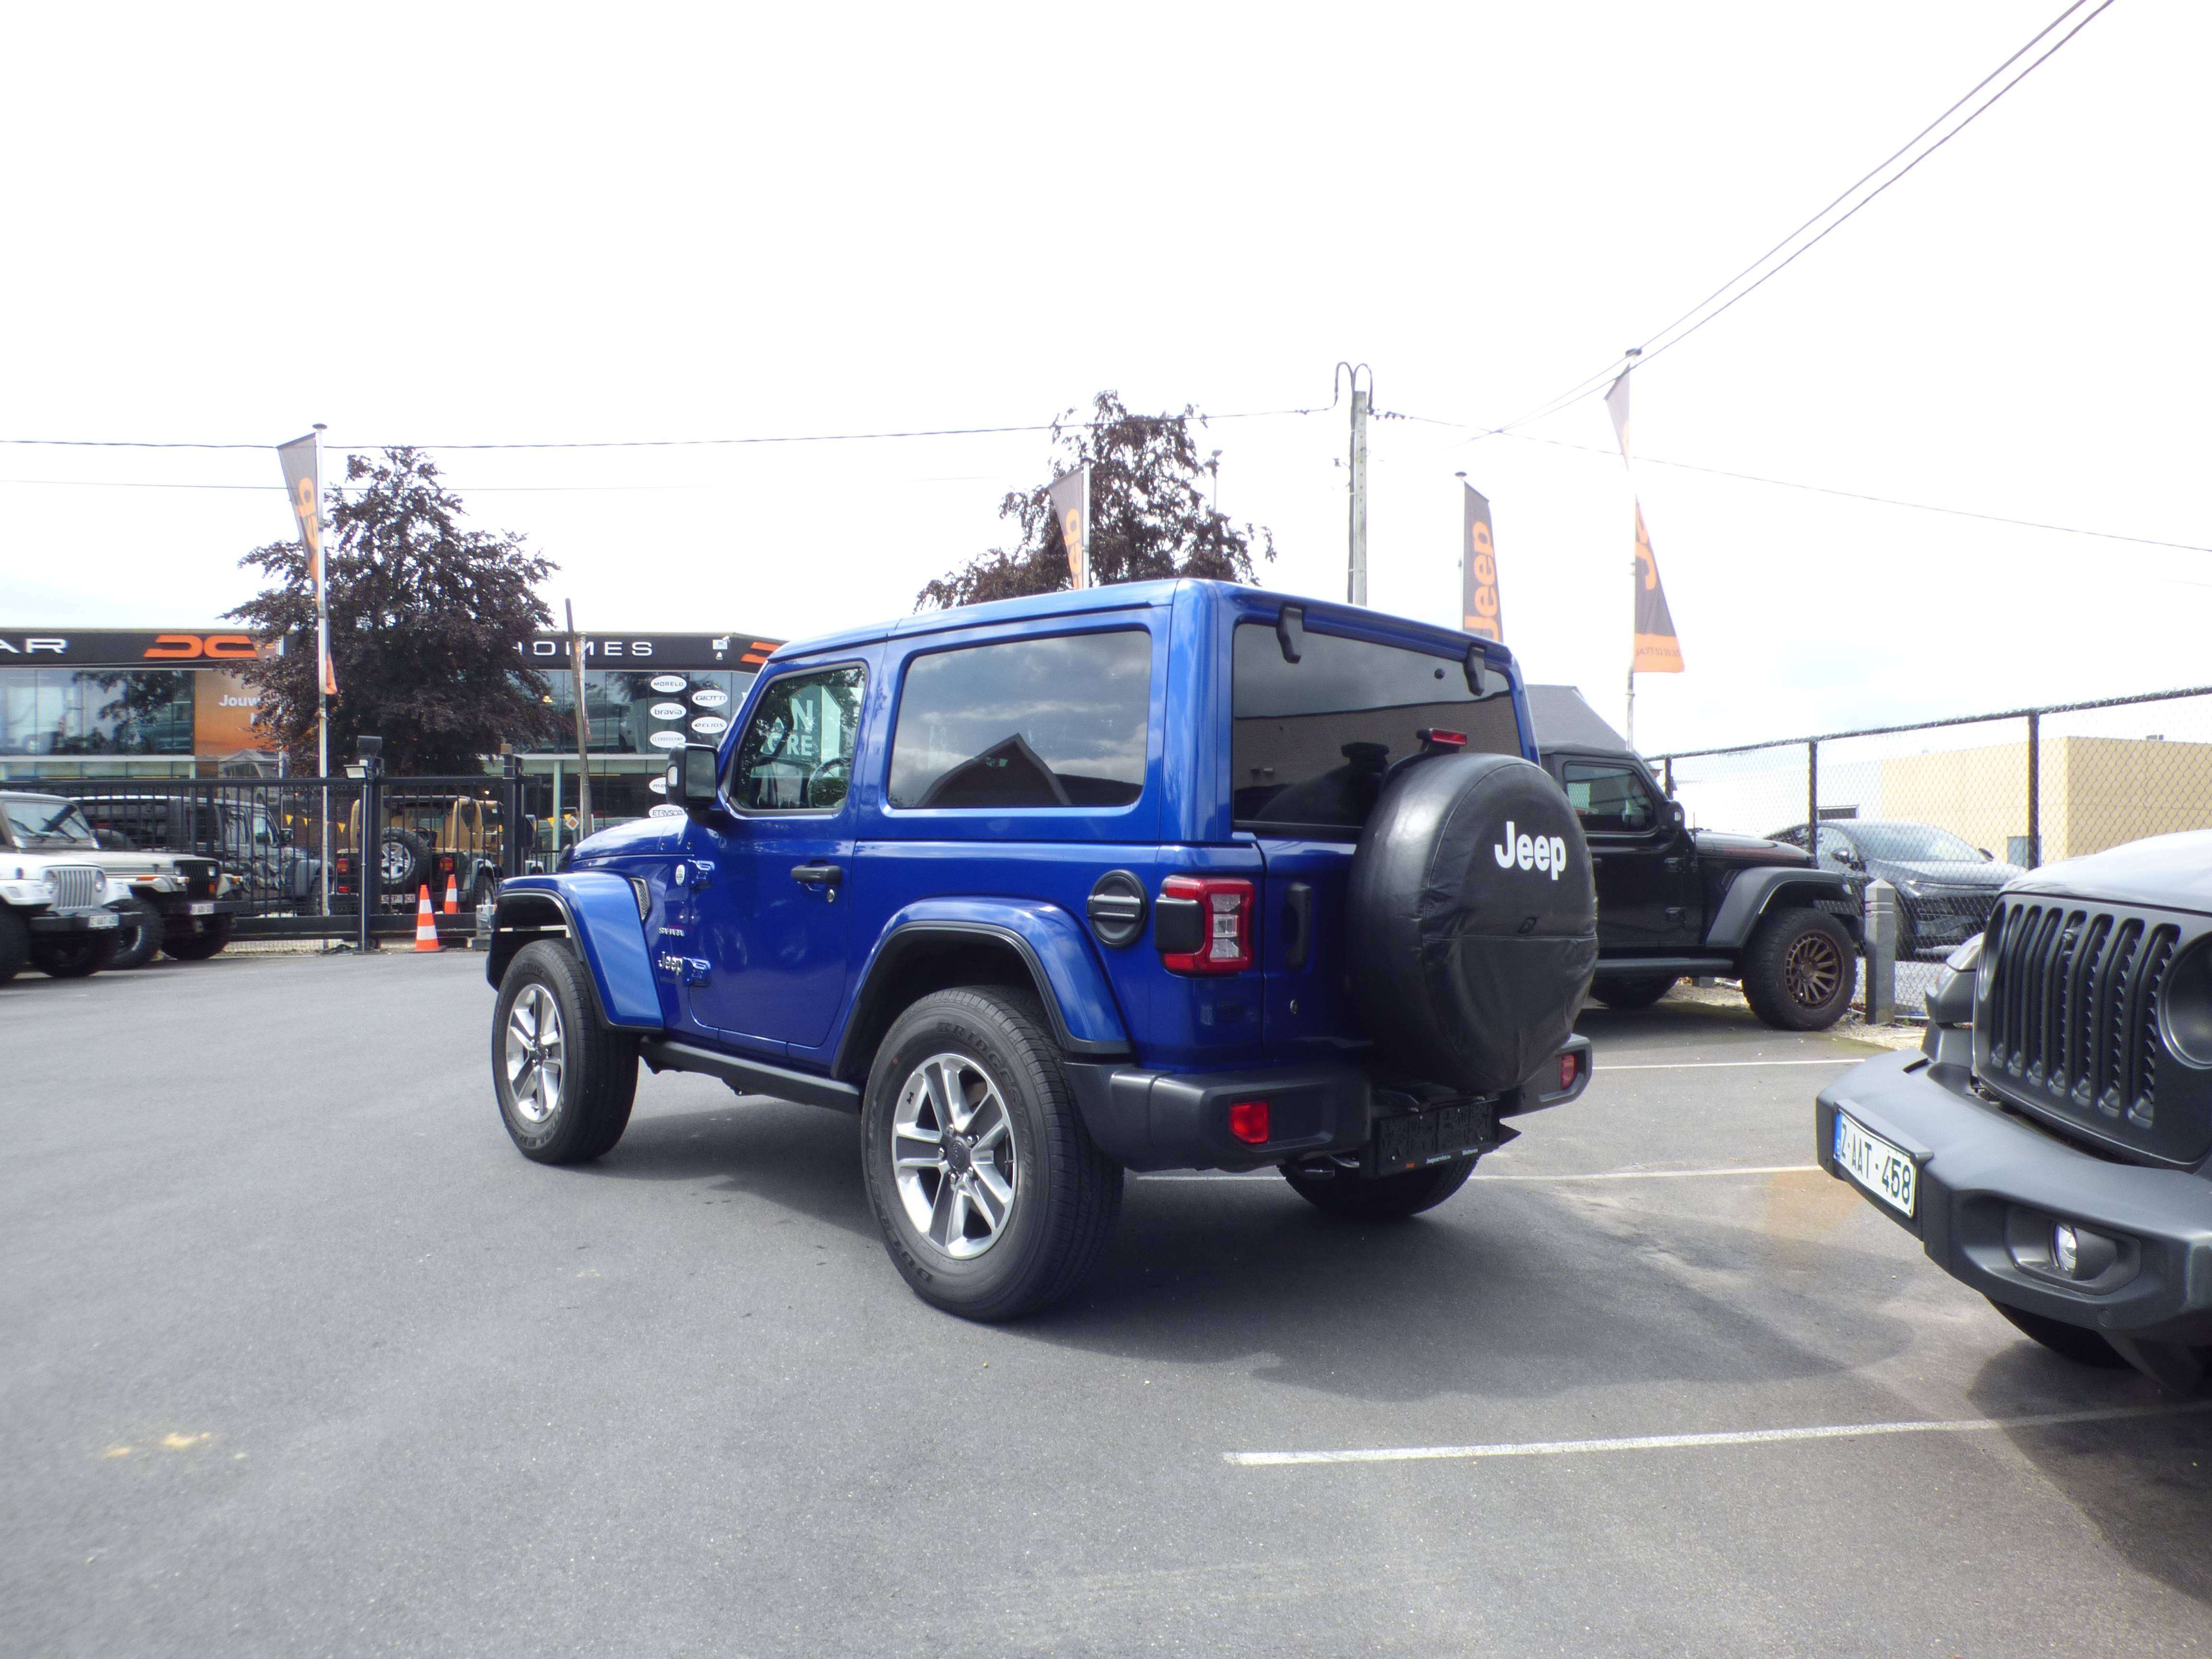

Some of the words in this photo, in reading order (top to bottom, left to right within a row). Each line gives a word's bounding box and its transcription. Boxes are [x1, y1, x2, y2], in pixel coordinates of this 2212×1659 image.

[1465, 521, 1499, 642] Jeep
[1494, 821, 1566, 880] Jeep
[658, 951, 683, 976] Jeep
